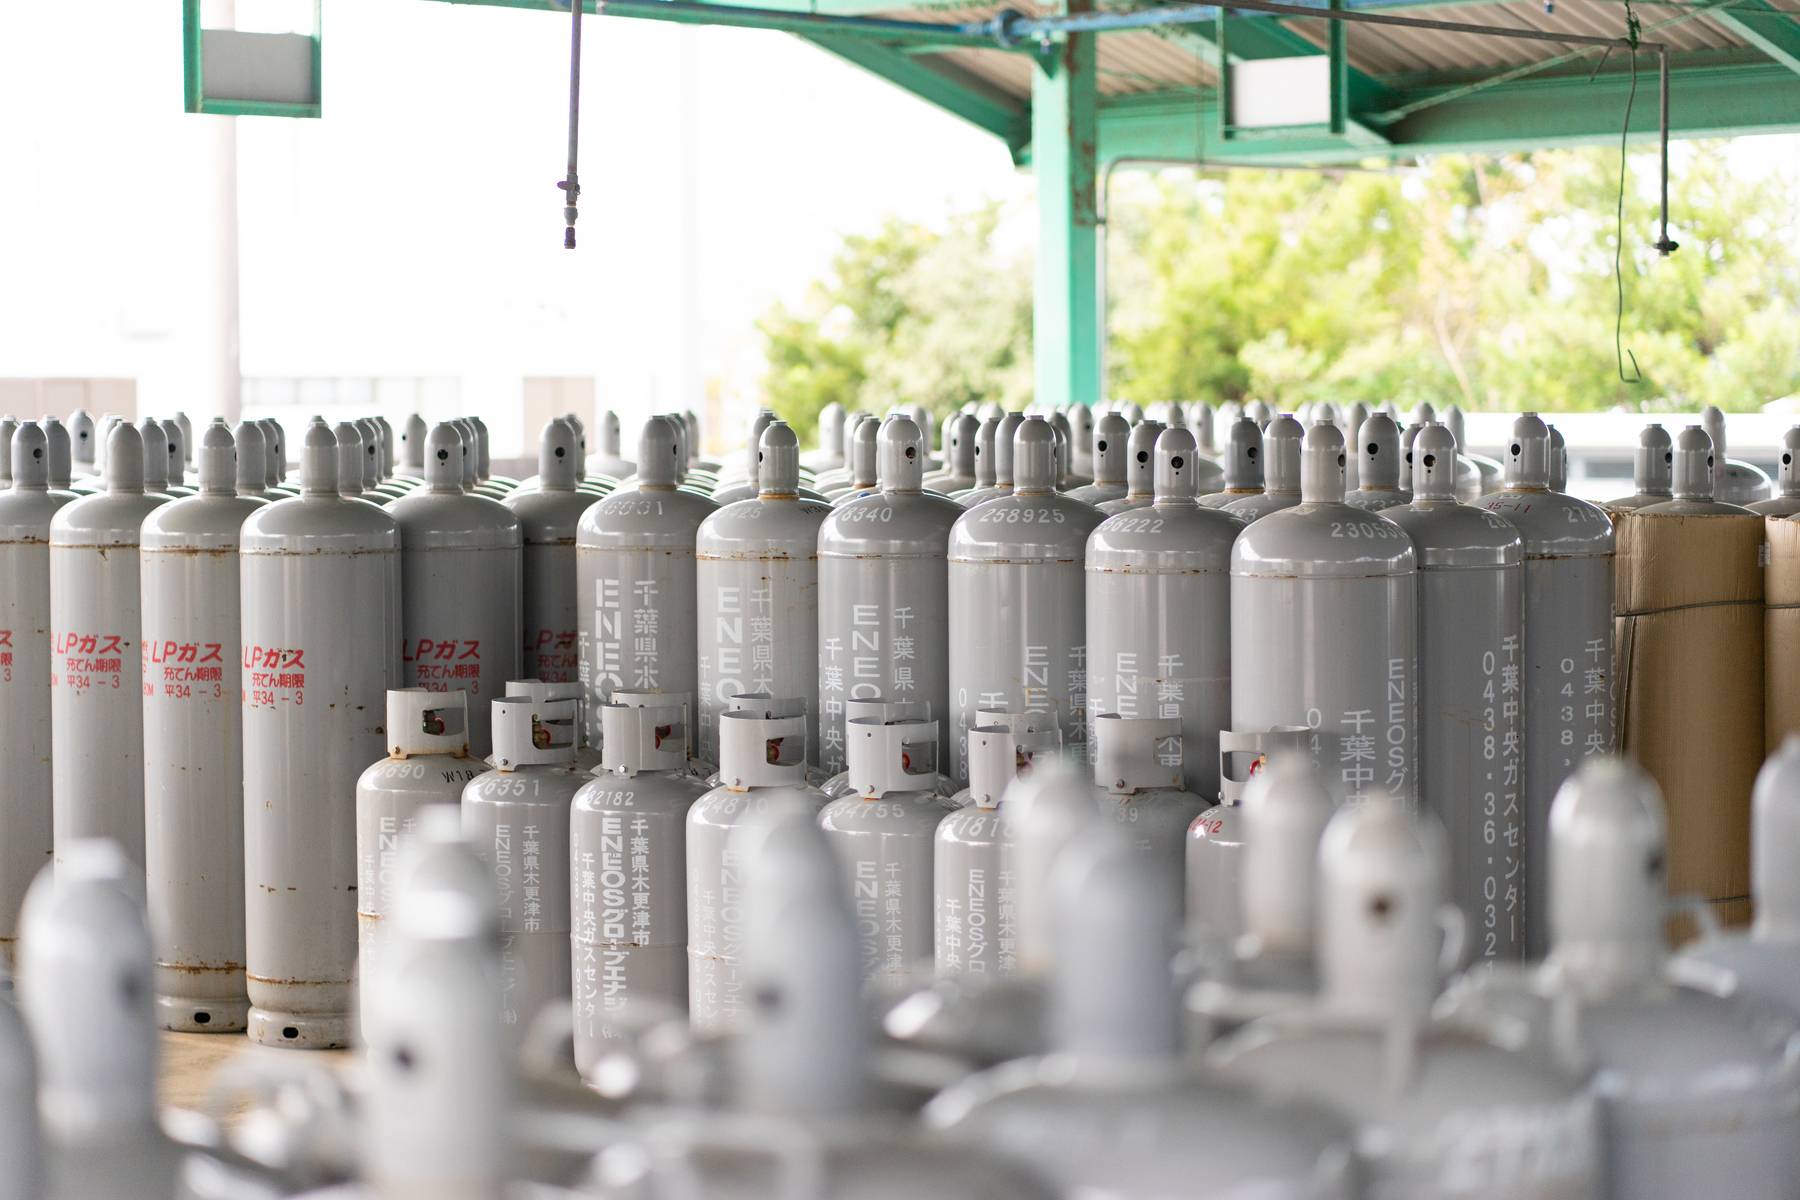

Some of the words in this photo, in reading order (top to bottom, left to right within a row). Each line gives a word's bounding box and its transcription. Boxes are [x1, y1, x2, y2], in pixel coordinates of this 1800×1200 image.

[57, 632, 122, 654] LPガス
[152, 640, 223, 663] LPガス
[244, 645, 306, 669] LPガス
[402, 638, 481, 662] LPガス
[893, 606, 915, 704] 千葉県
[1023, 646, 1049, 714] ENE
[1116, 652, 1138, 719] ENE
[1501, 634, 1519, 942] 千葉中央ガスセンター
[523, 825, 541, 932] 千葉県木更津市
[630, 818, 651, 948] 千葉県木更津市
[884, 862, 904, 986] 千葉県木更津
